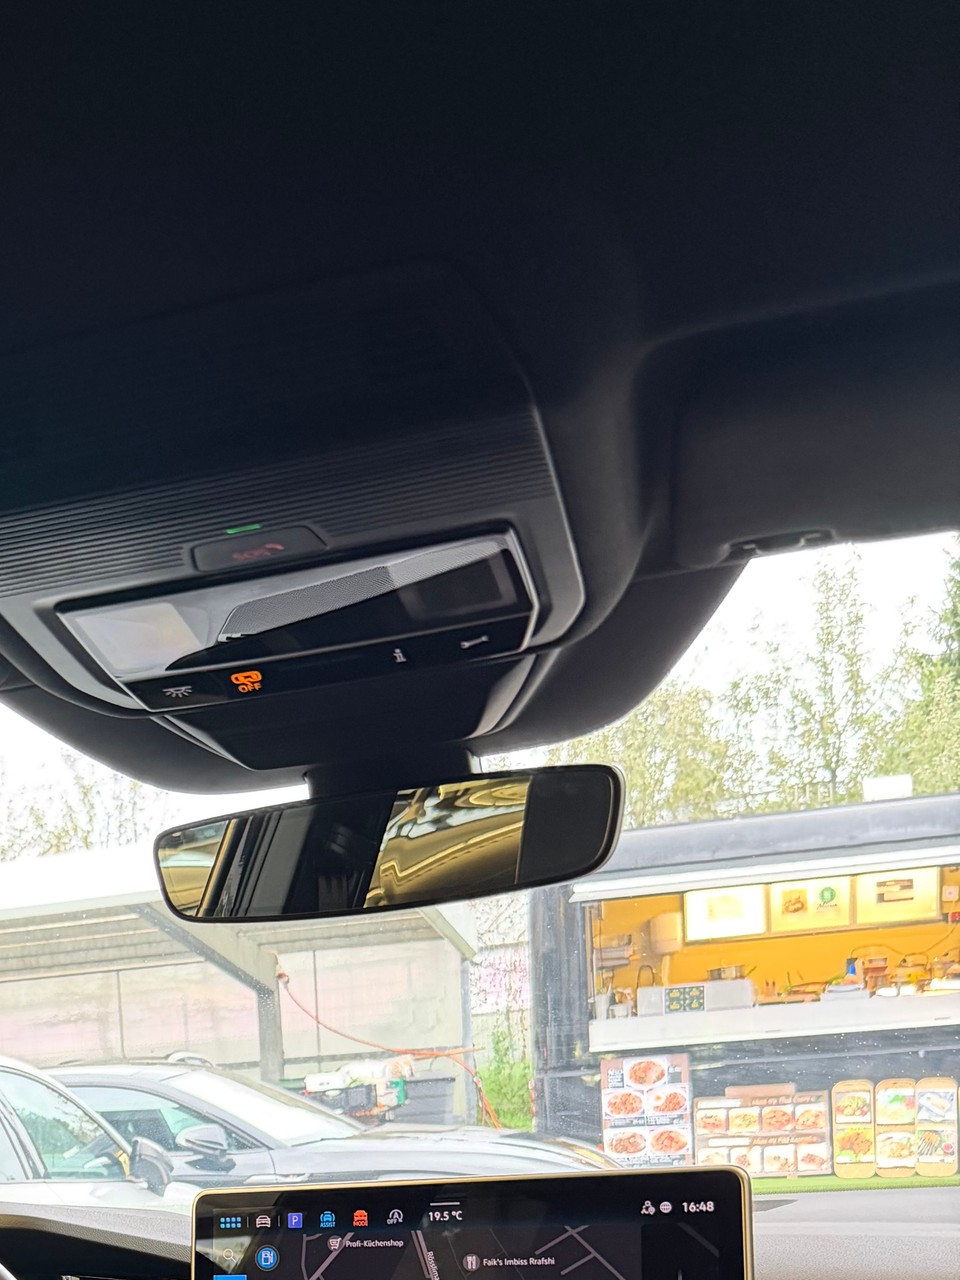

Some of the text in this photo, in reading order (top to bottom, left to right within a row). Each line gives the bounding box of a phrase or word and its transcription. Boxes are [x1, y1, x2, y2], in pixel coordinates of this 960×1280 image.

[237, 682, 262, 693] OFF
[681, 1201, 715, 1213] 16:48
[292, 1215, 299, 1226] P
[428, 1211, 449, 1221] 19.5
[345, 1240, 404, 1249] Profi-Küchenshop
[483, 1257, 555, 1266] Faik's Imbiss Rrafshi
